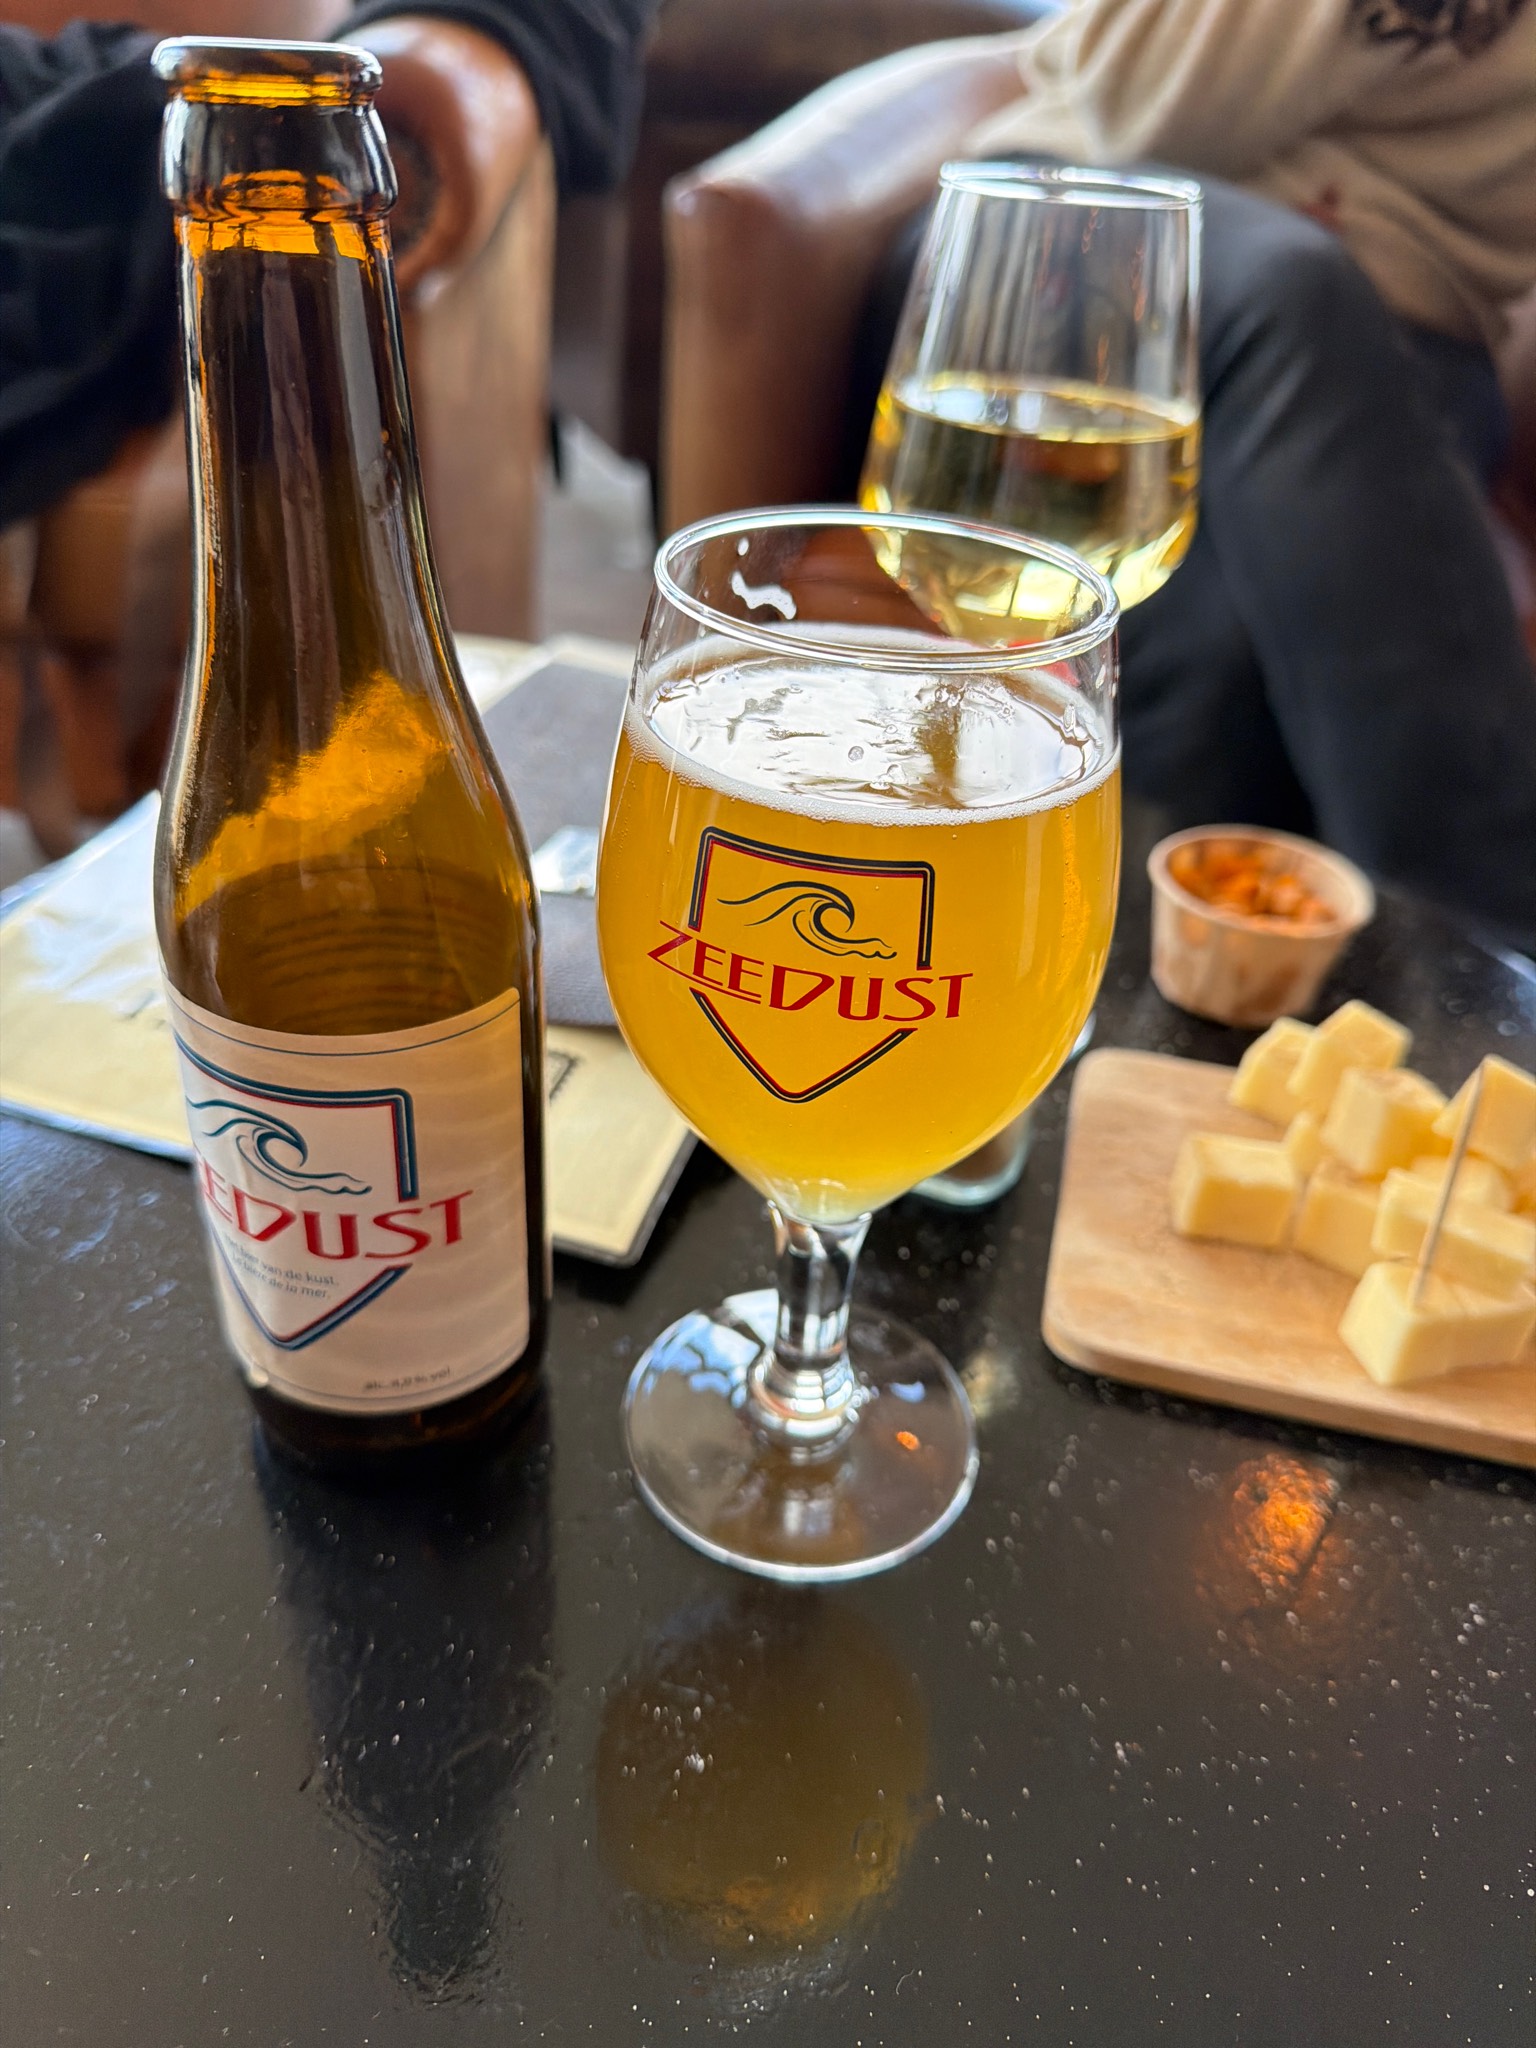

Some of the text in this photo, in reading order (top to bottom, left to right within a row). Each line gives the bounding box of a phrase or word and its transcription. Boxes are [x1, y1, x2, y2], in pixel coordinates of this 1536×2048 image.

[647, 920, 974, 1021] ZEEDUST
[202, 1157, 474, 1260] EDUST
[261, 1261, 283, 1276] van
[285, 1269, 302, 1281] de
[305, 1270, 340, 1287] kust.
[268, 1276, 284, 1290] de
